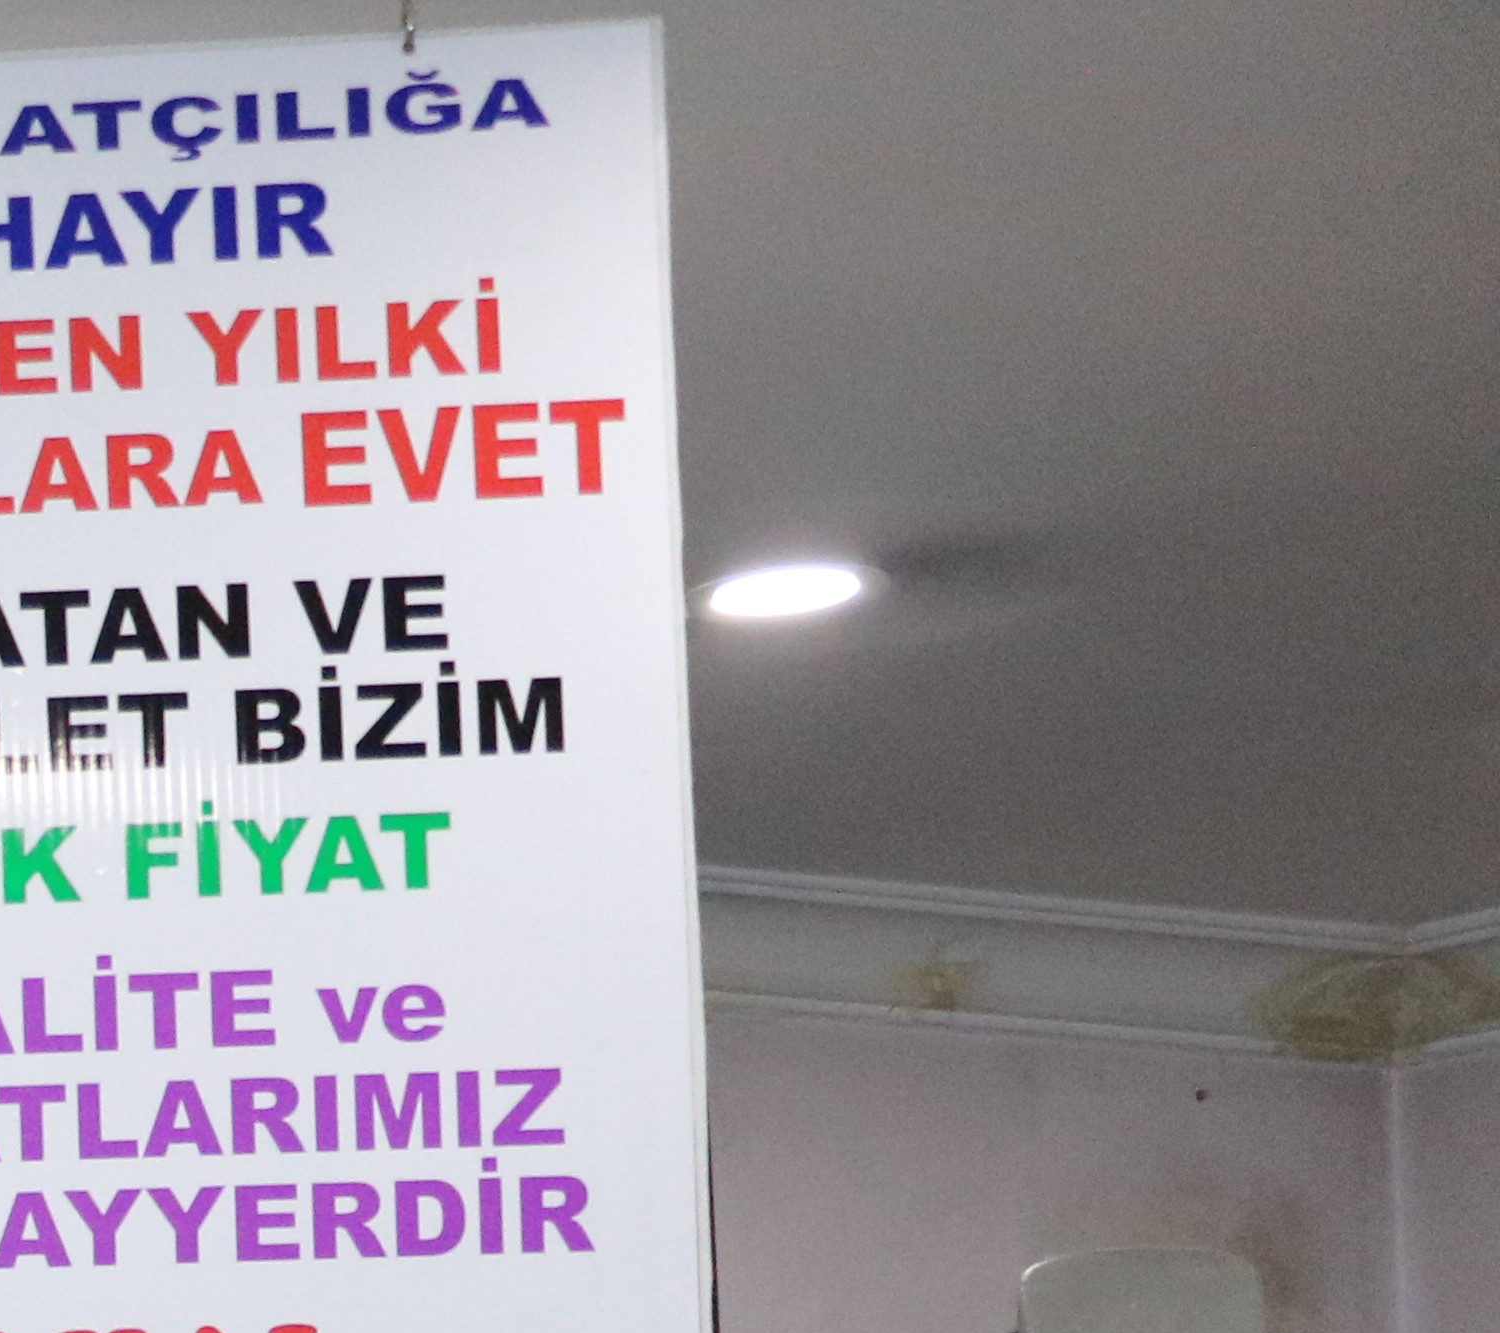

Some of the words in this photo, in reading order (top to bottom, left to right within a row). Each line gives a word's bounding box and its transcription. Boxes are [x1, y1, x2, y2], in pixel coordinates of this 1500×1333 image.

[188, 277, 503, 383] YILKİ
[302, 398, 625, 506] EVET
[295, 575, 447, 652] VE
[236, 662, 564, 764] BİZİM
[126, 801, 450, 900] FİYAT
[318, 982, 445, 1041] ve
